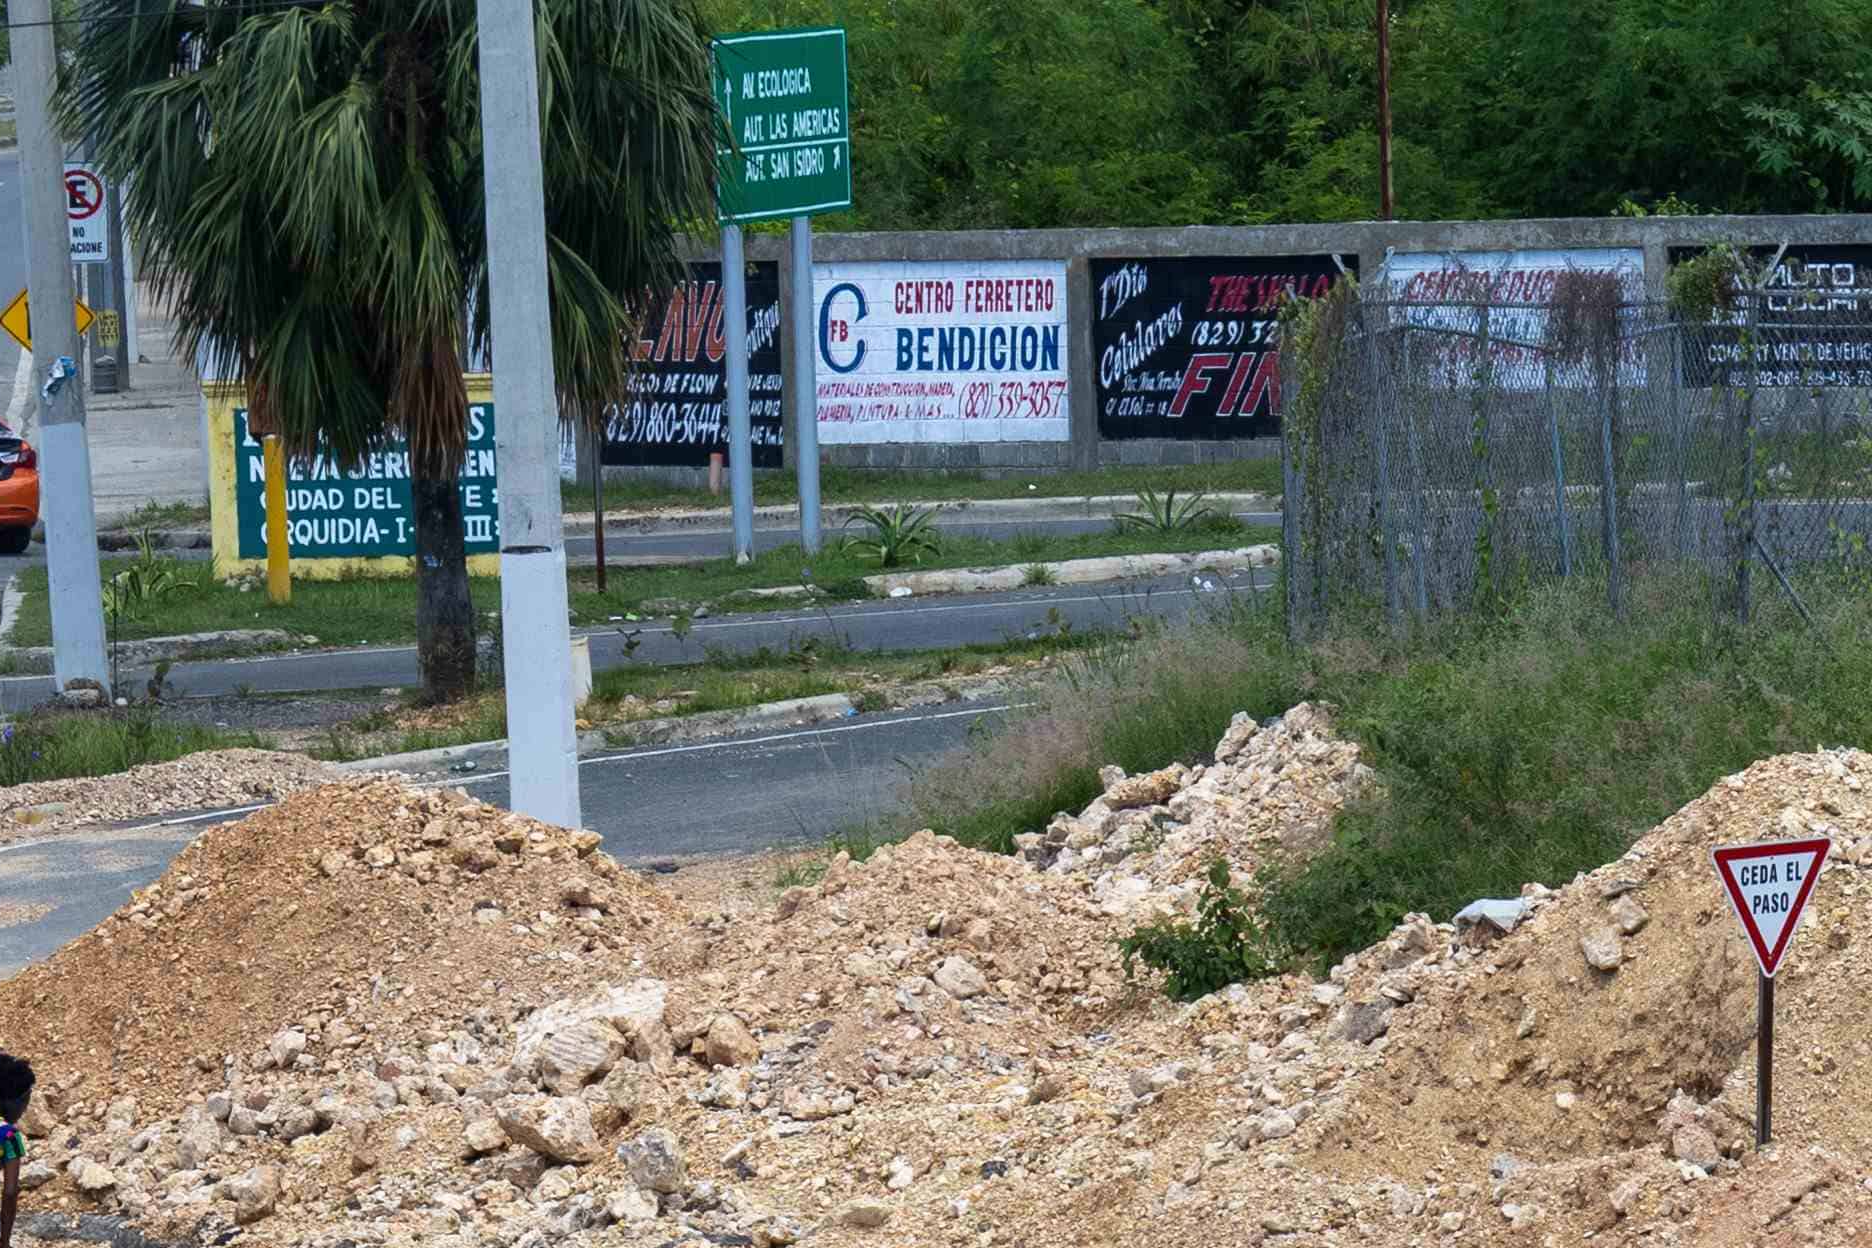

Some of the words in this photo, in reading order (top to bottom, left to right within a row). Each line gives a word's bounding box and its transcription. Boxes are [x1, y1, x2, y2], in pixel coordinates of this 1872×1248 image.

[758, 67, 811, 98] ECOLOGICA
[744, 114, 765, 143] AUT.
[769, 113, 788, 140] LAS
[792, 107, 840, 138] AMERICAS
[771, 151, 789, 179] SAN
[794, 147, 824, 177] ISIDRO
[72, 226, 85, 237] NO
[70, 242, 103, 253] ACIONE
[895, 281, 954, 314] CENTRO
[965, 279, 1054, 313] FERRETERO
[830, 320, 848, 342] FB
[896, 325, 1059, 371] BENDICION
[681, 373, 719, 394] FLOW
[249, 454, 341, 483] NEVA
[354, 488, 402, 510] DEL
[1741, 863, 1779, 887] CEDA
[1786, 861, 1802, 881] EL
[1753, 892, 1790, 914] PASO
